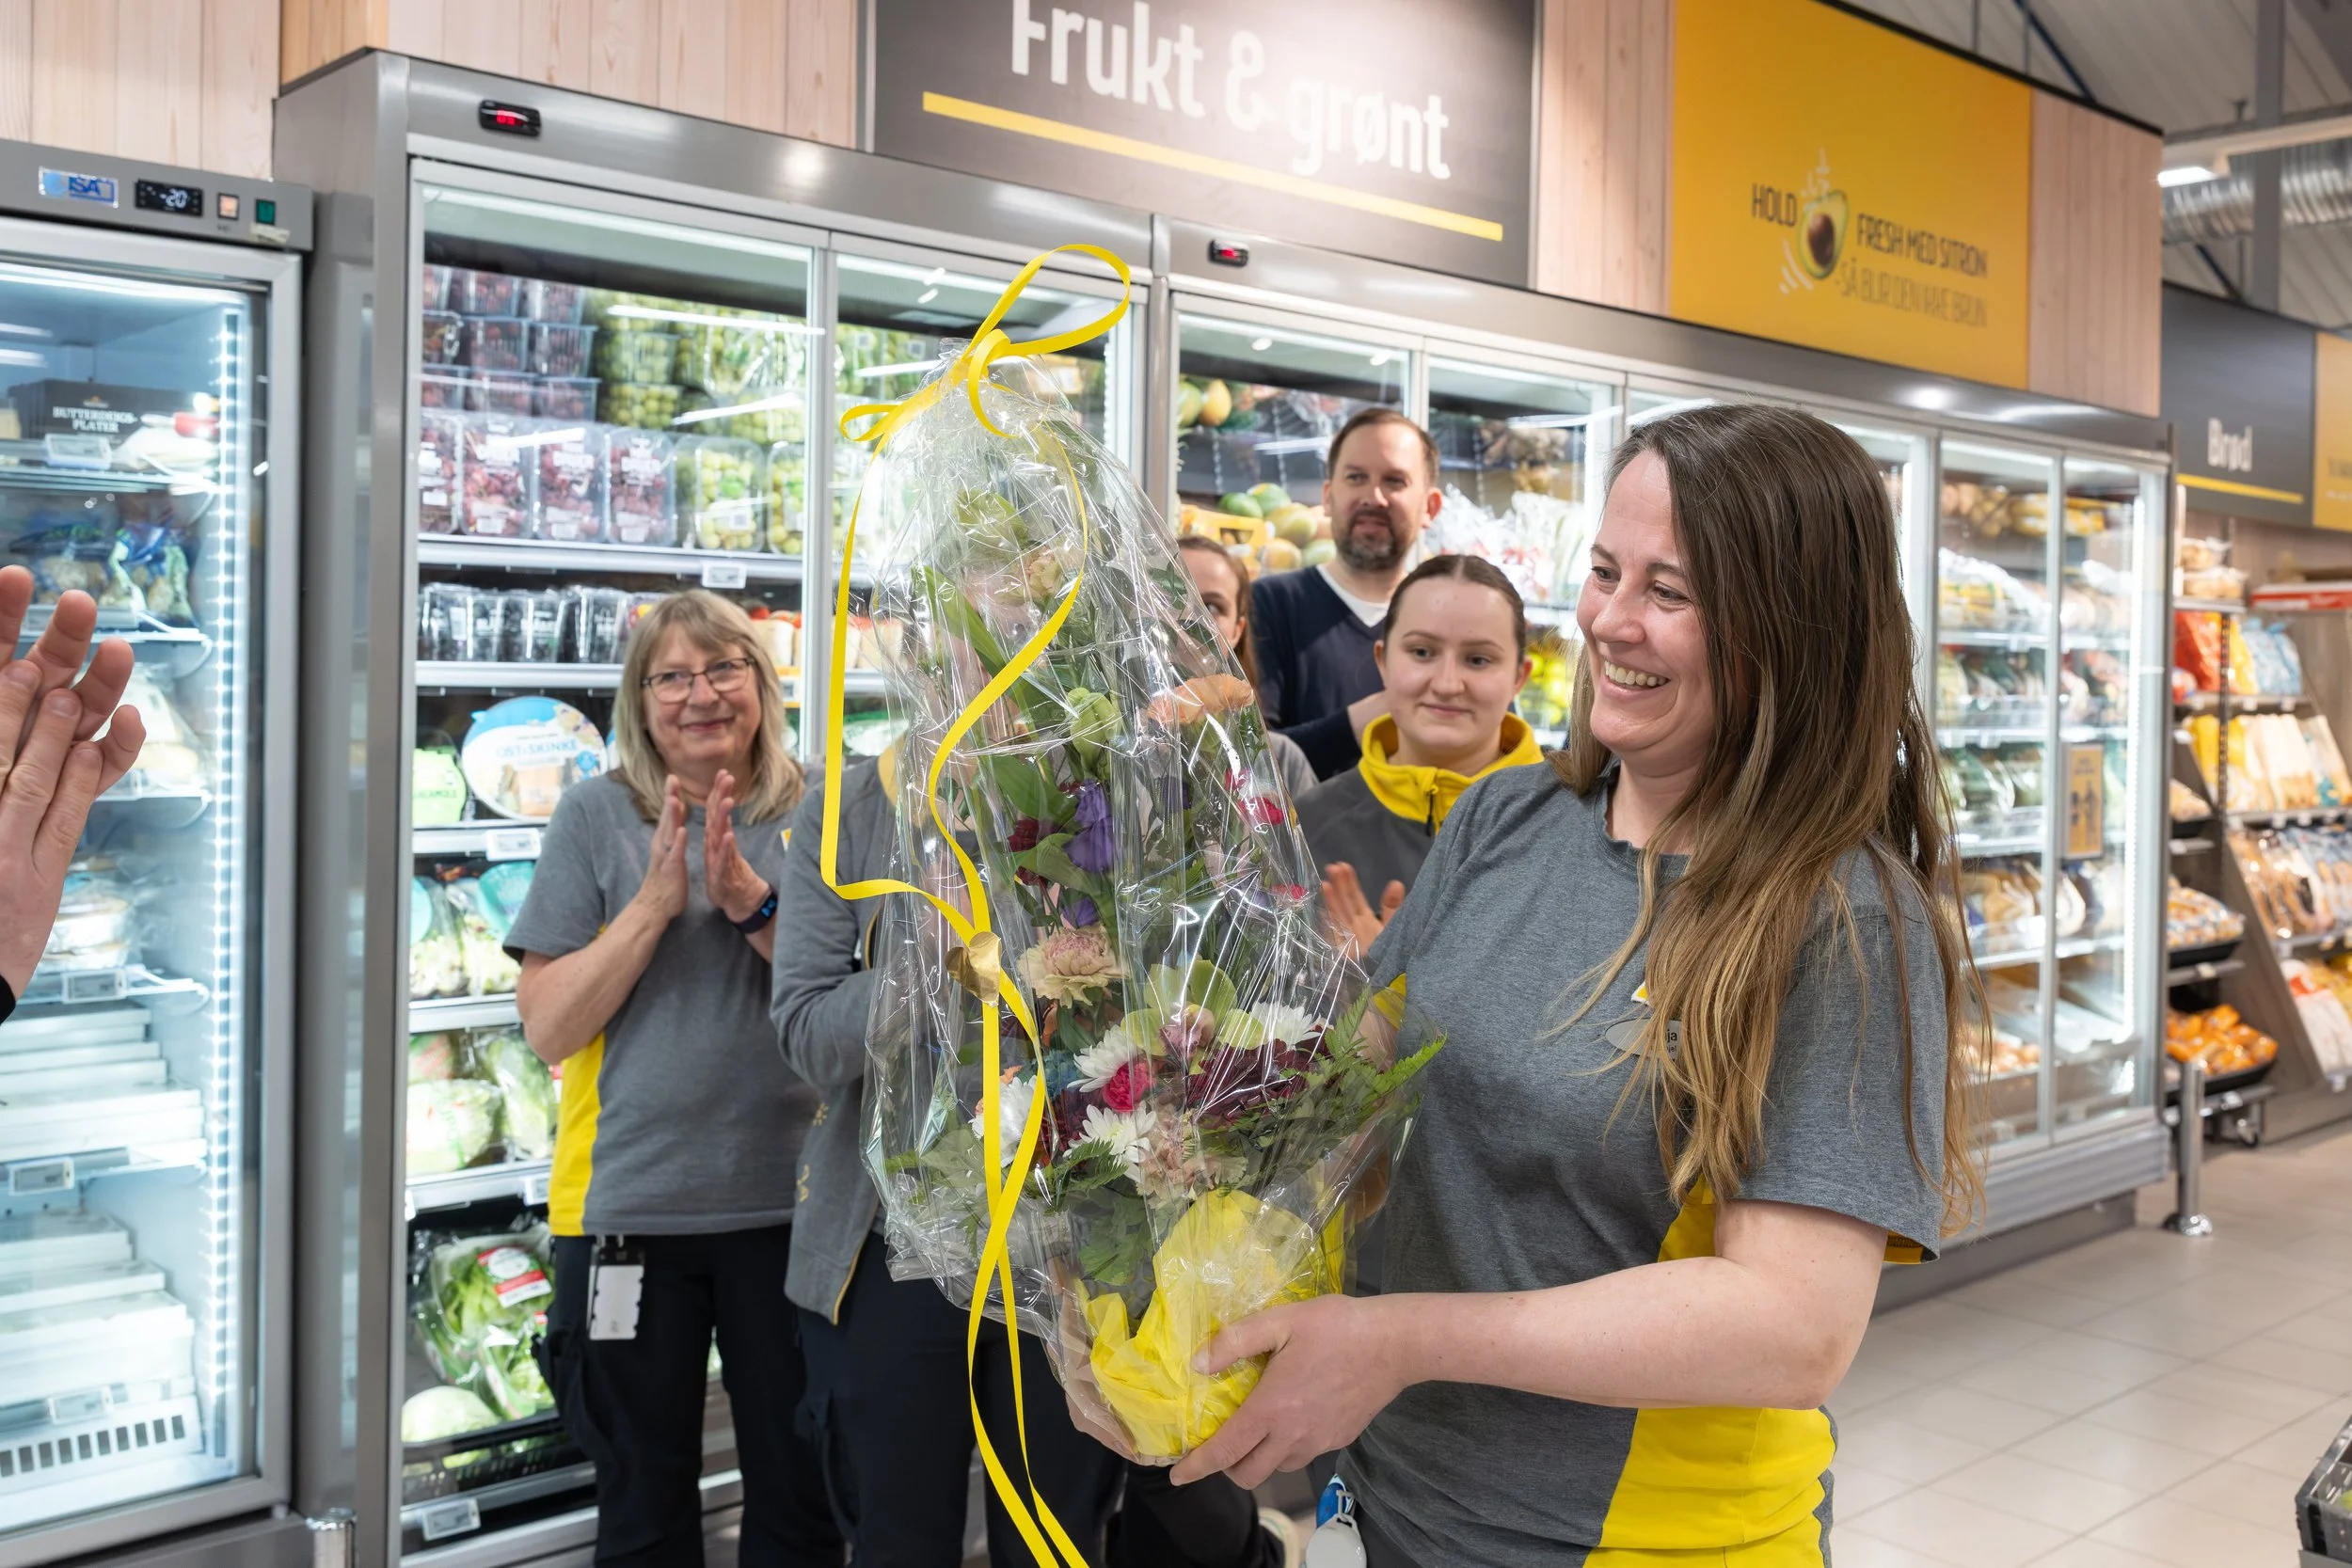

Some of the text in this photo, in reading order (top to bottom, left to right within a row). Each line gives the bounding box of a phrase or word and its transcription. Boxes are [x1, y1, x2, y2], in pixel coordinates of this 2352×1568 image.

[1011, 0, 1451, 179] Frukt & grønt
[68, 175, 101, 195] ISA
[1752, 182, 1989, 279] HOLD FRESH MED SITRON
[2208, 418, 2253, 471] Brød
